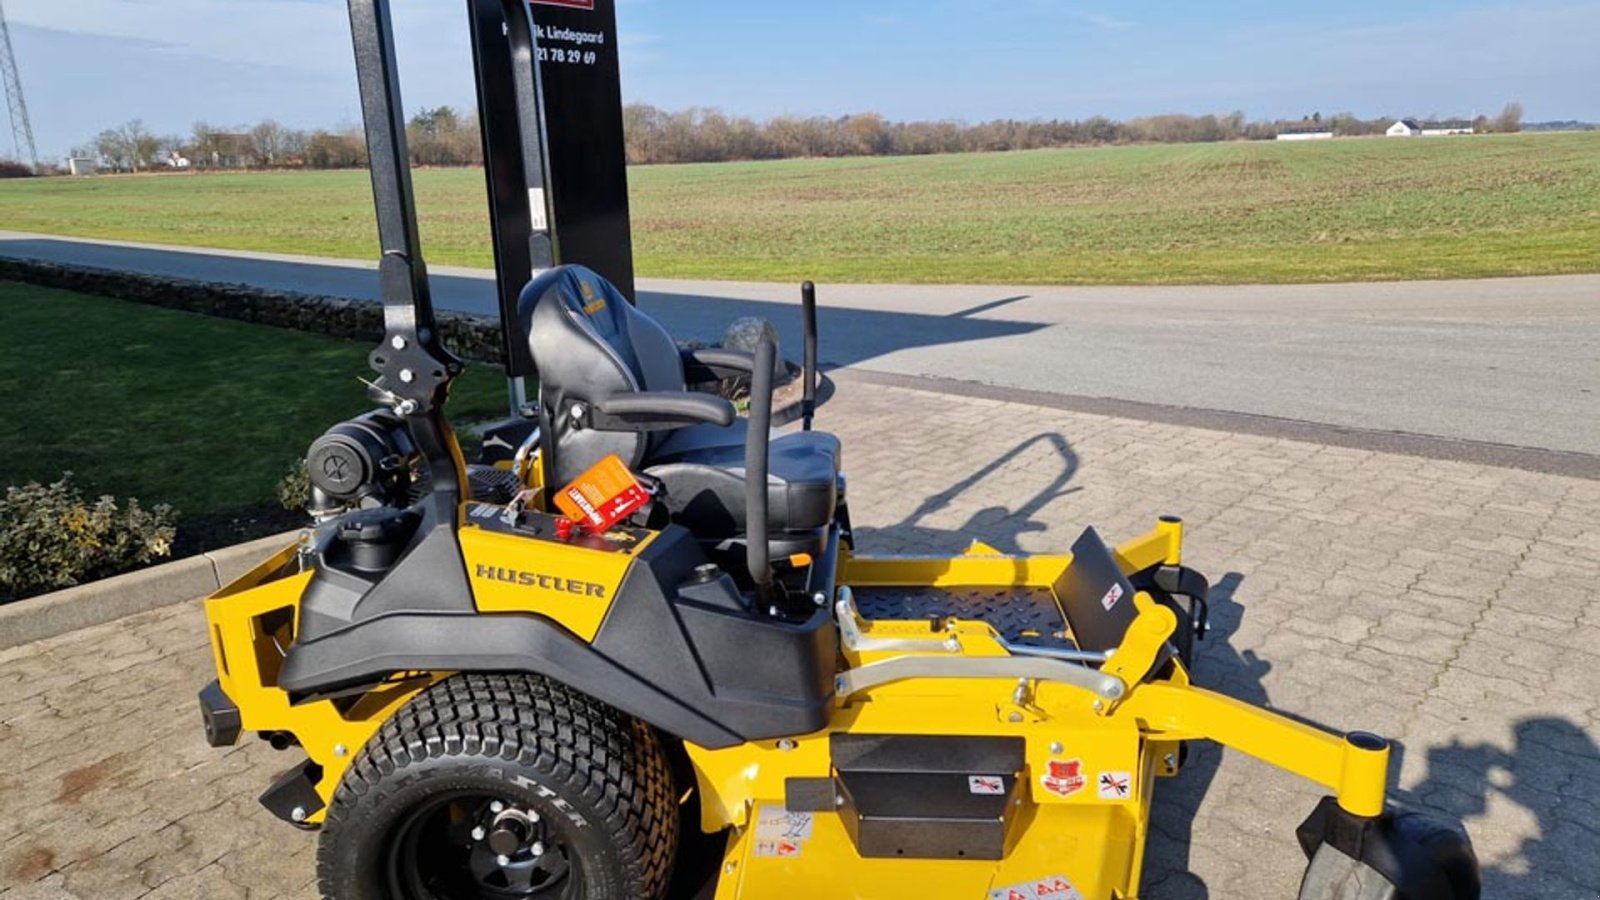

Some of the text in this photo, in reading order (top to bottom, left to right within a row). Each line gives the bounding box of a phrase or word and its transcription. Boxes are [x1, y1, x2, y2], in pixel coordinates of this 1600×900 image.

[502, 21, 604, 45] Hik Lindegaard
[550, 48, 565, 62] 78
[567, 50, 581, 63] 29
[583, 51, 596, 64] 69
[476, 563, 605, 598] HUSTLER
